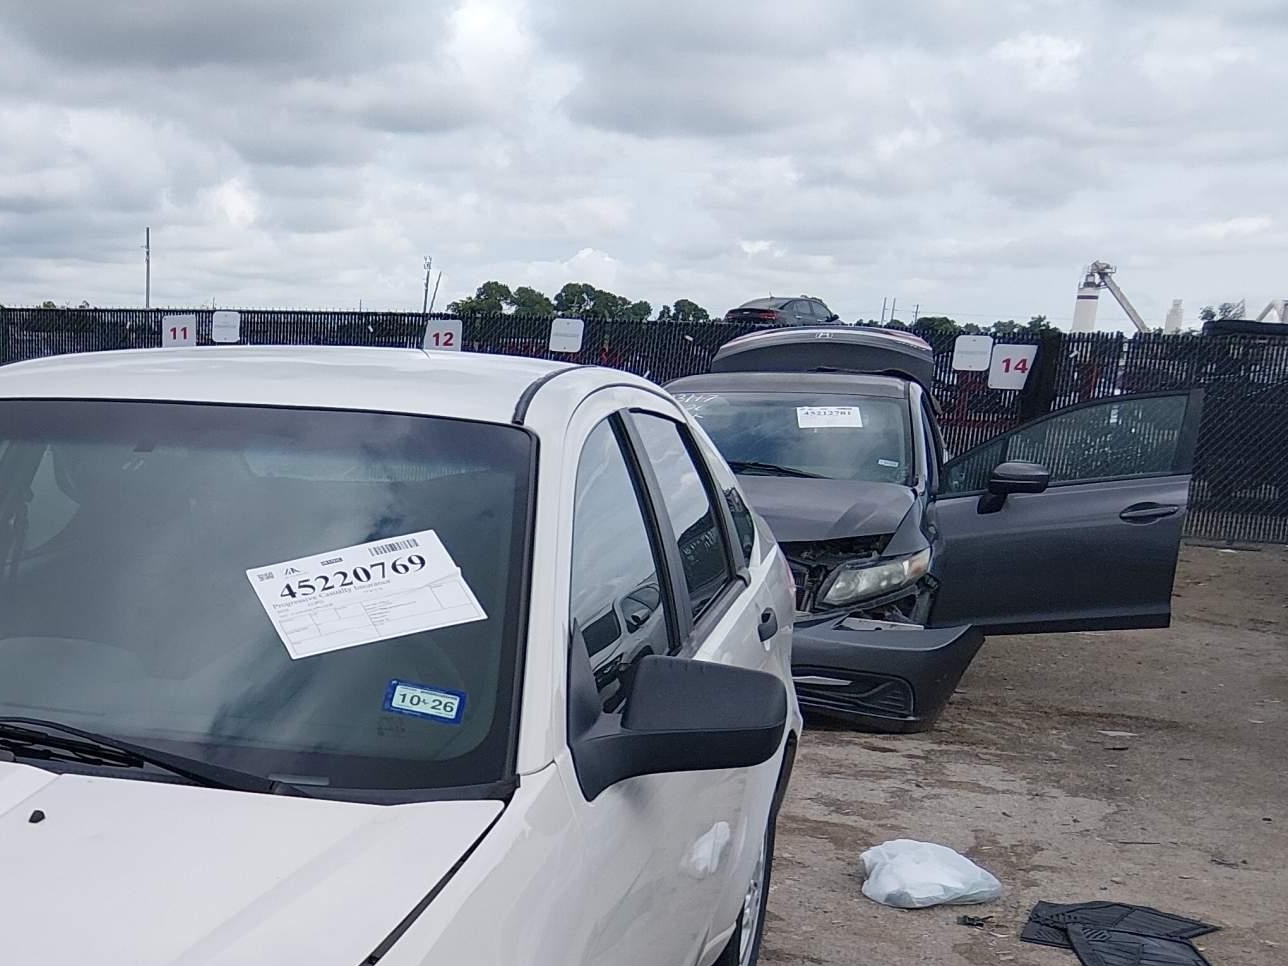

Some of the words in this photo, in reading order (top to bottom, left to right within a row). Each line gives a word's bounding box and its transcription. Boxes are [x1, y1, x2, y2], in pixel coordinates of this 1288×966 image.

[170, 327, 188, 340] 11
[432, 332, 454, 346] 12
[1002, 358, 1029, 373] 14
[280, 554, 426, 599] 45220769
[272, 594, 314, 609] Progressive
[318, 585, 353, 599] Casualty
